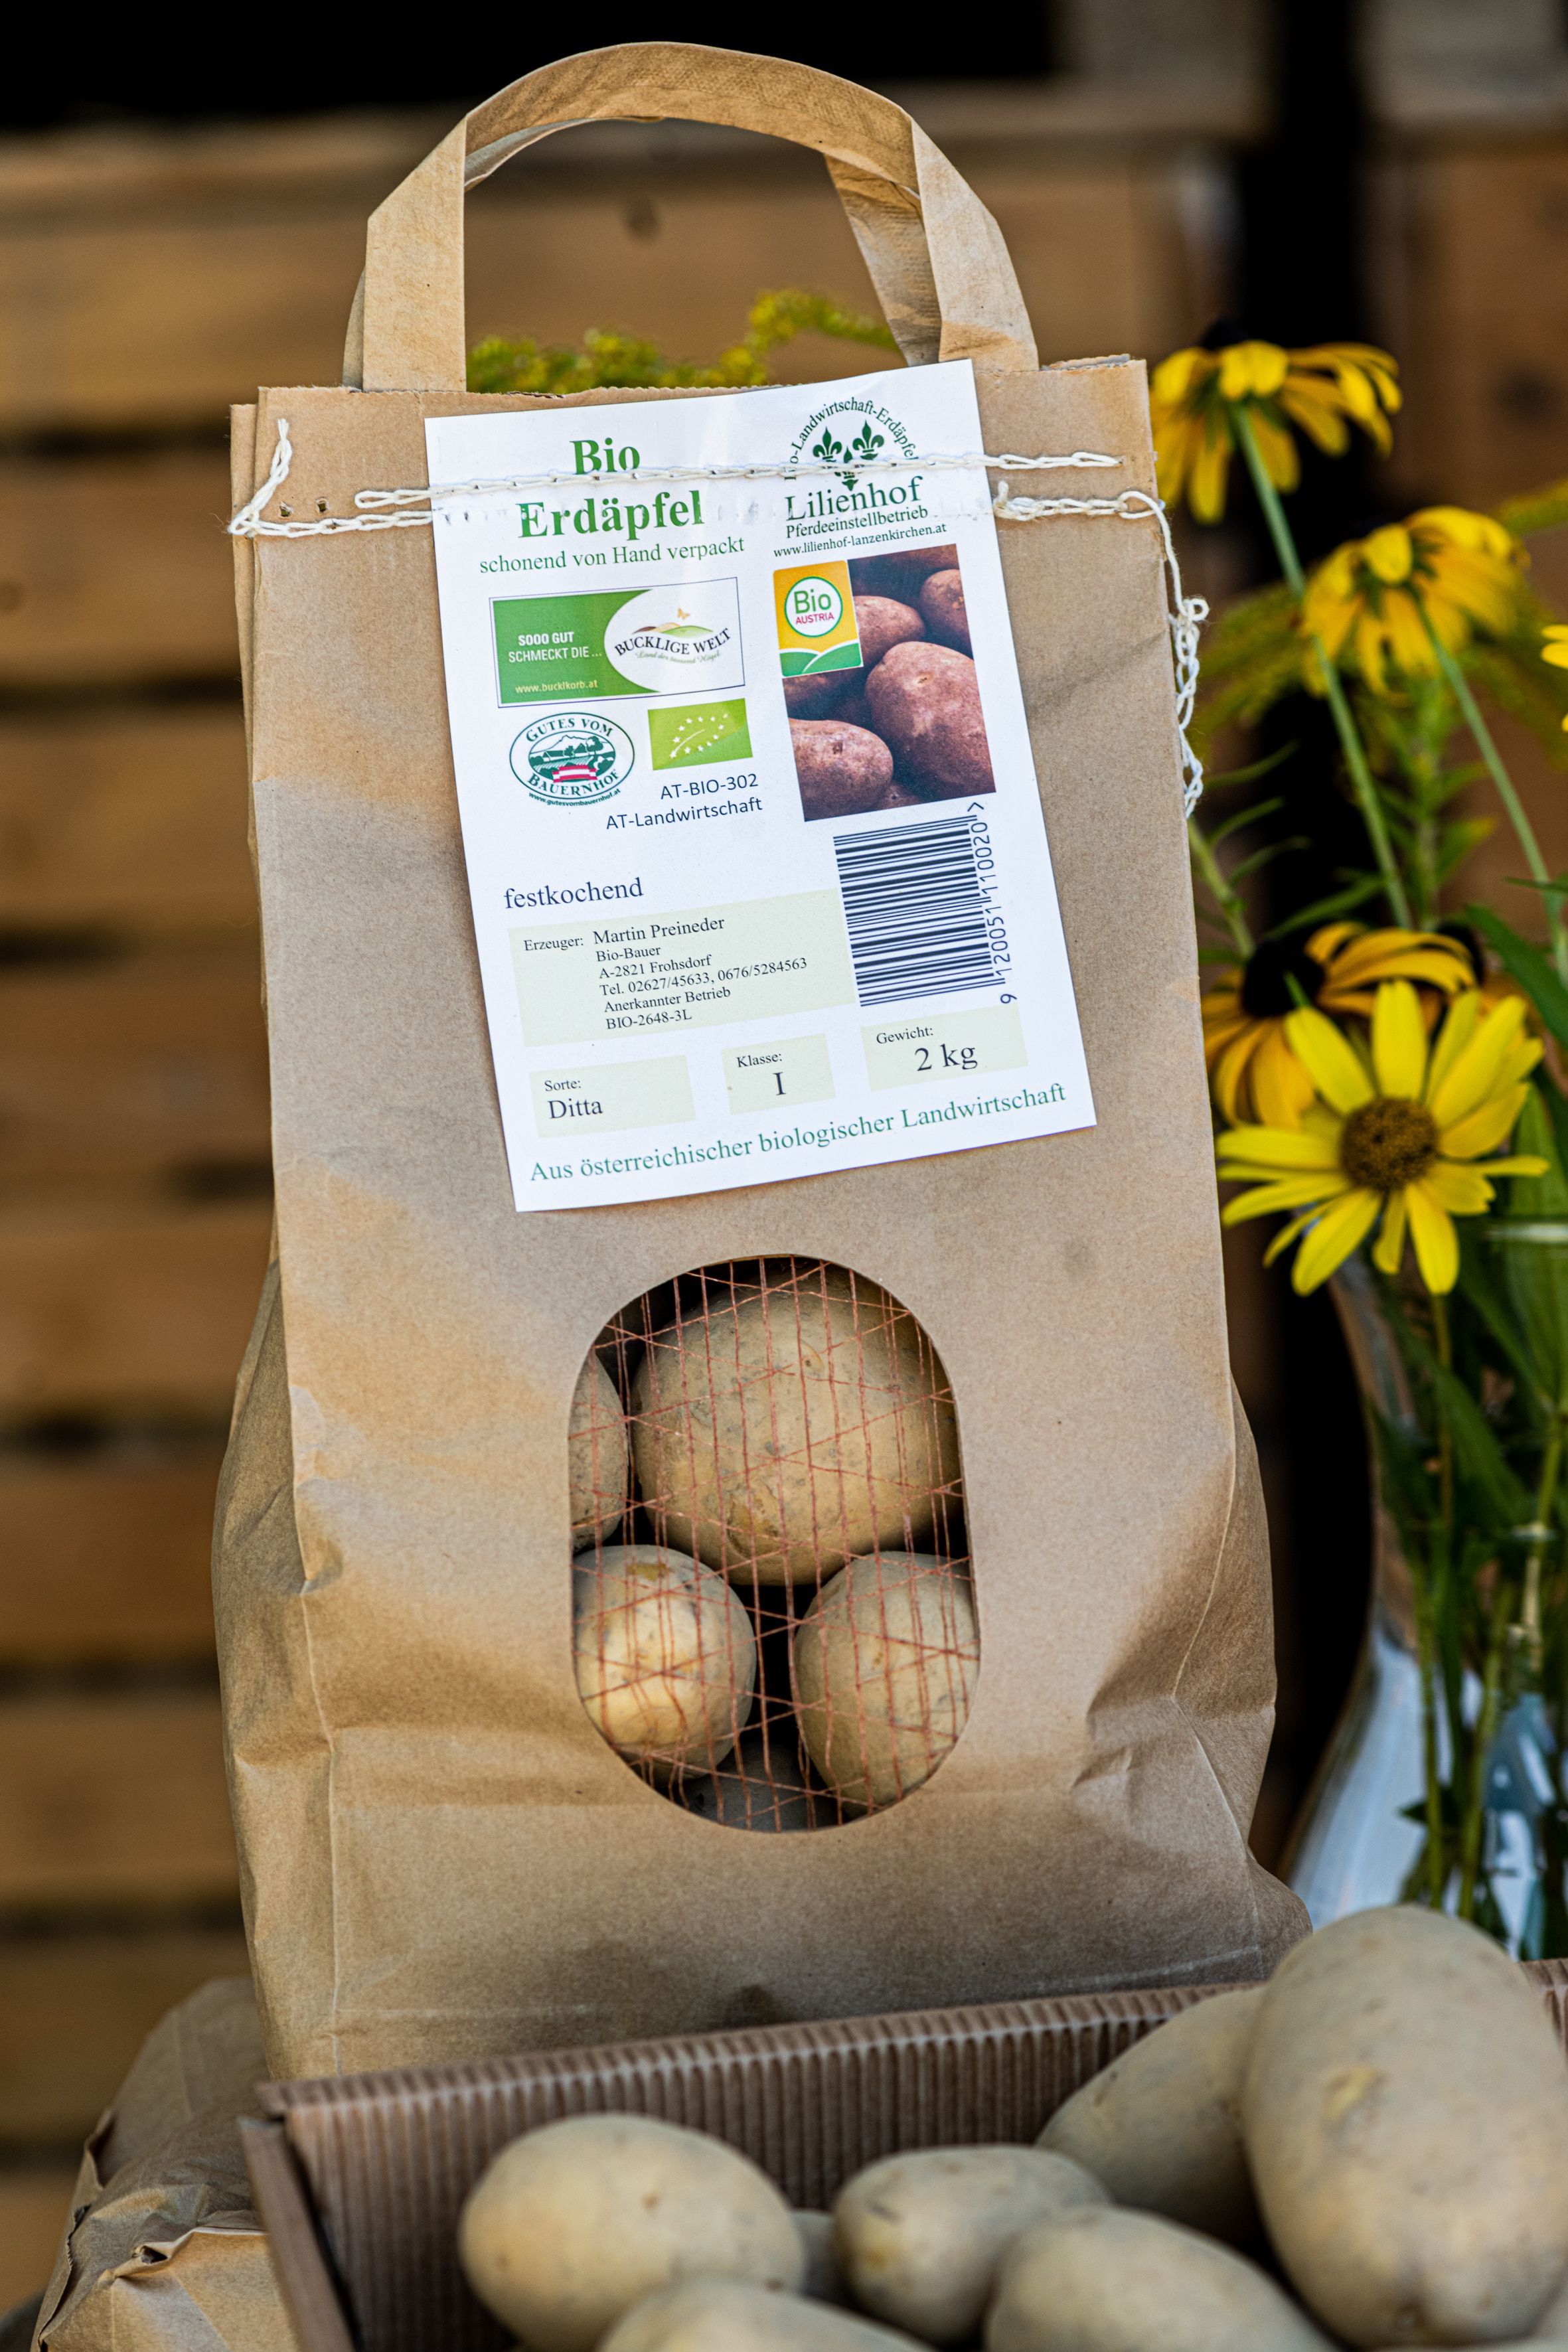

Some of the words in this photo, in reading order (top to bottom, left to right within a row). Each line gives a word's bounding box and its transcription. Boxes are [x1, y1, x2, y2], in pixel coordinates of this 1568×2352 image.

[570, 437, 640, 475] Bio
[785, 475, 923, 521] Lilienhof
[516, 490, 704, 540] Erdäpfel
[786, 505, 928, 538] Pferdeeinstellbetrieb
[773, 523, 947, 557] www.lilienhof-lanzenkirchen.at
[480, 551, 566, 573] schonend
[572, 552, 607, 567] von
[613, 544, 661, 564] Hand
[666, 536, 745, 561] verpackt
[794, 588, 832, 614] Bio
[796, 612, 834, 625] AUSTRIA
[518, 633, 549, 646] SOOO
[552, 631, 574, 644] GUT
[614, 636, 690, 657] BUCKLIGE
[693, 628, 731, 653] WELT
[509, 648, 568, 663] SCHMECKT
[571, 646, 589, 659] DIE
[515, 680, 597, 693] www.bucklkorb.at
[526, 718, 575, 742] GUTES
[581, 718, 613, 737] VOM
[528, 769, 619, 796] BAUERNHOF
[661, 773, 759, 800] AT-BIO-302
[528, 788, 621, 807] www.gutesvombauernhof.at
[606, 797, 763, 830] AT-Landwirtschaft
[503, 876, 645, 909] festkochend
[524, 936, 584, 951] Erzeuger:
[592, 927, 646, 945] Martin
[650, 917, 725, 939] Preineder
[595, 946, 661, 962] Bio-Bauer
[599, 963, 645, 979] A-2821
[650, 954, 712, 974] Frohsdorf
[599, 983, 624, 996] Tel.
[628, 972, 715, 993] 02627/45633,
[718, 957, 807, 981] 0676/5284563
[604, 994, 681, 1012] Anerkannter
[685, 986, 731, 1002] Betrieb
[606, 1009, 692, 1030] BIO-2648-3L
[876, 1026, 934, 1044] Gewicht:
[736, 1053, 783, 1068] Klasse:
[914, 1048, 932, 1071] 2
[939, 1044, 979, 1070] kg
[544, 1079, 582, 1092] Sorte:
[773, 1071, 787, 1096] I
[548, 1097, 603, 1119] Ditta
[530, 1162, 574, 1181] Aus
[580, 1139, 753, 1177] österreichischer
[759, 1116, 894, 1152] biologischer
[900, 1082, 1067, 1129] Landwirtschaft
